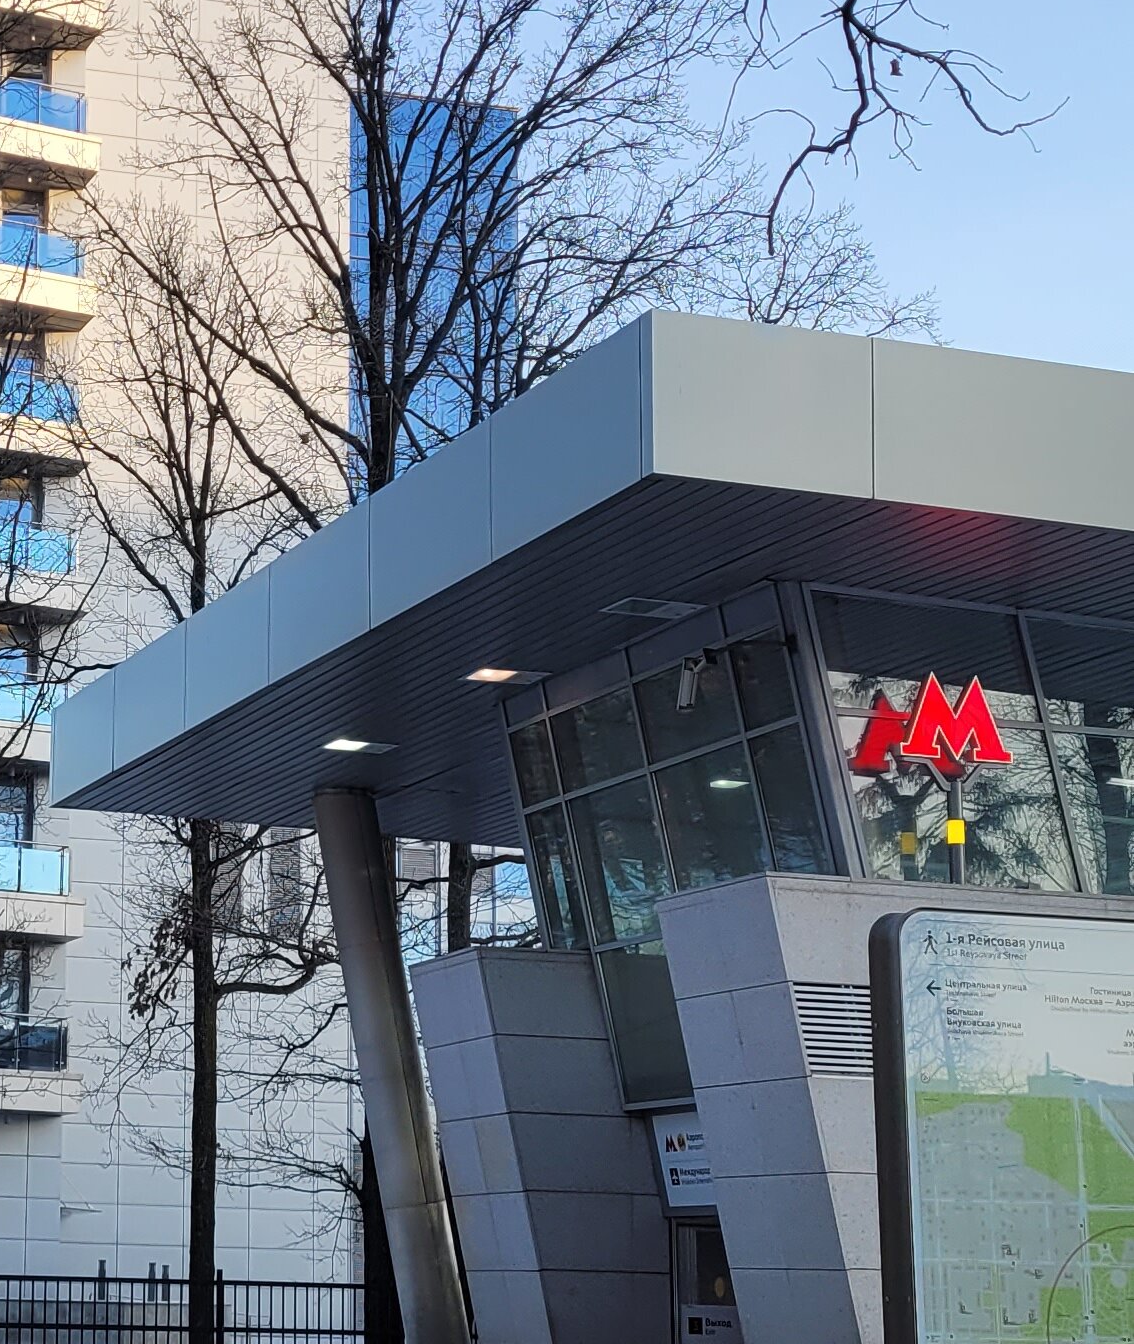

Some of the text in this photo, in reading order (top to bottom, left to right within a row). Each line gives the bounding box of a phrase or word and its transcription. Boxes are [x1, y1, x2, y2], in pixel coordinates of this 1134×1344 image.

[968, 933, 1026, 948] Рейсовая
[1028, 939, 1066, 951] улица
[1044, 994, 1070, 1003] Hilton
[705, 1317, 733, 1328] Выход
